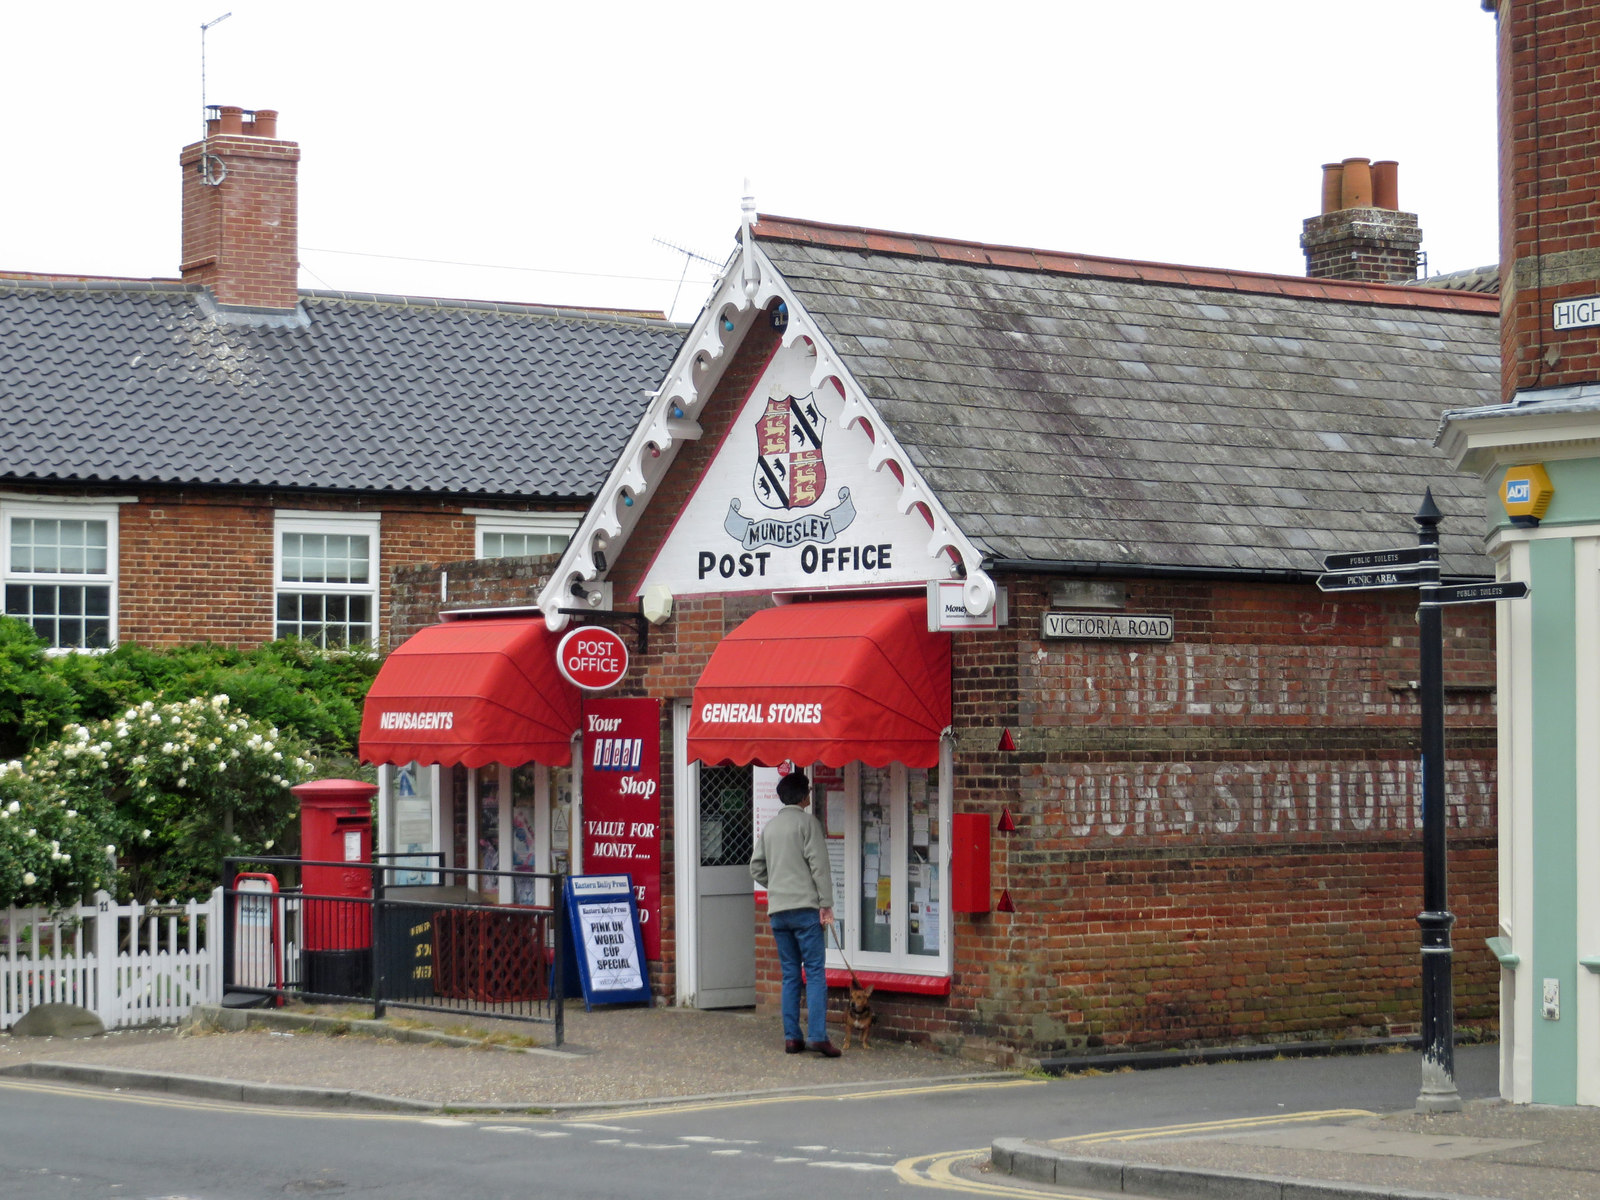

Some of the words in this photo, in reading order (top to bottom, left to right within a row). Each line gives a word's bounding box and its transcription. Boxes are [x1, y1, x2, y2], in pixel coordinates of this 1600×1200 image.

[1557, 302, 1600, 326] HIGH
[1507, 485, 1529, 499] ADT
[749, 518, 829, 546] MUNDESLEY
[698, 551, 771, 580] POST
[801, 544, 892, 574] OFFICE
[1350, 556, 1371, 565] PUBLIC
[1374, 554, 1399, 562] TOILETS
[1347, 575, 1372, 584] PICNIC
[1375, 574, 1398, 583] AREA
[1456, 589, 1478, 598] PUBLIC
[1480, 587, 1503, 596] TOILETS
[1050, 617, 1121, 635] VICTORIA
[1128, 620, 1169, 637] ROAD
[578, 640, 614, 656] POST
[568, 656, 619, 673] OFFICE
[380, 711, 454, 730] NEWSAGENTS
[702, 703, 764, 723] GENERAL
[767, 702, 822, 723] STORES
[587, 714, 622, 732] Your
[593, 739, 643, 769] ideal
[619, 776, 656, 799] Shop
[588, 821, 625, 838] VALUE
[629, 823, 656, 838] FOR
[574, 881, 596, 890] Eastern
[597, 881, 611, 890] Daily
[612, 880, 627, 888] Press
[99, 902, 109, 912] 11
[601, 907, 613, 915] Daily
[591, 922, 611, 933] PINK
[594, 933, 625, 945] WORLD
[603, 947, 620, 958] CUP
[597, 958, 631, 970] SPECIAL
